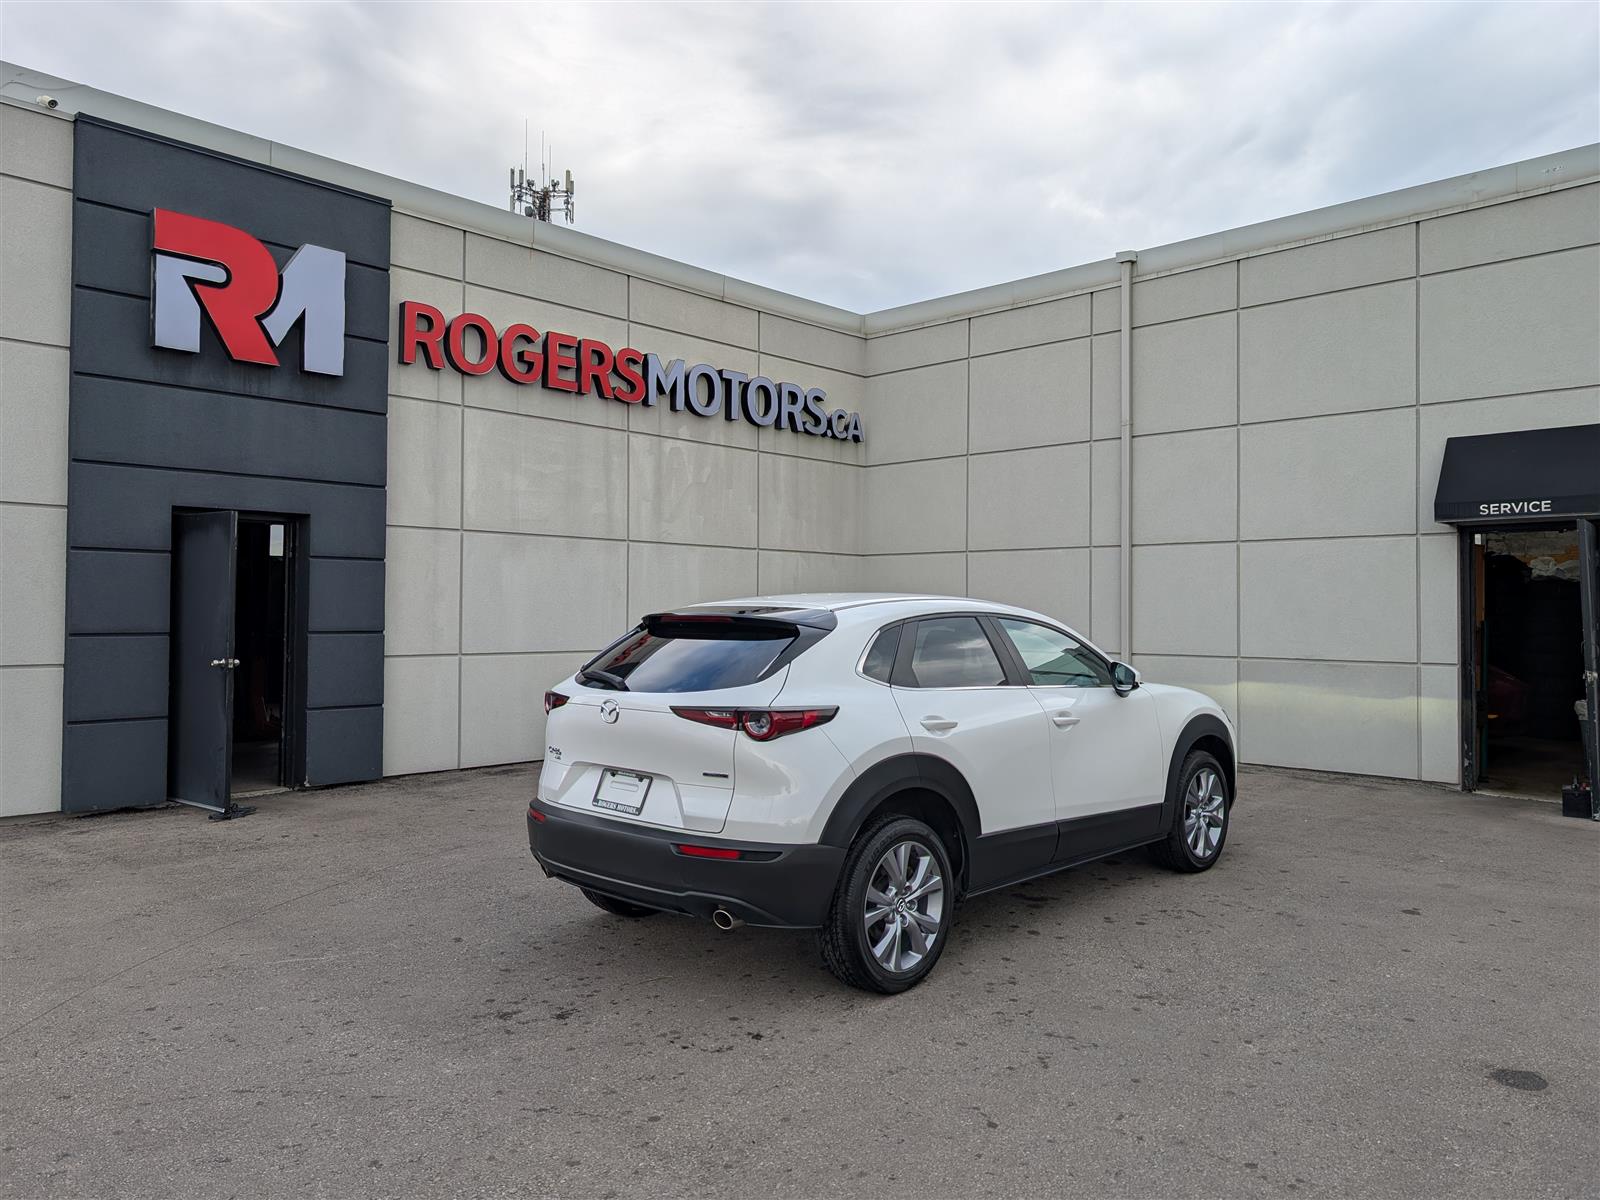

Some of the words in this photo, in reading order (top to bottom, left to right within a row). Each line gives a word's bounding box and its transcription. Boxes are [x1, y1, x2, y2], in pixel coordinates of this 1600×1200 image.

[152, 207, 346, 377] RM
[1480, 500, 1552, 515] SERVICE
[598, 800, 617, 810] ROGERS
[616, 803, 636, 813] MOTORS
